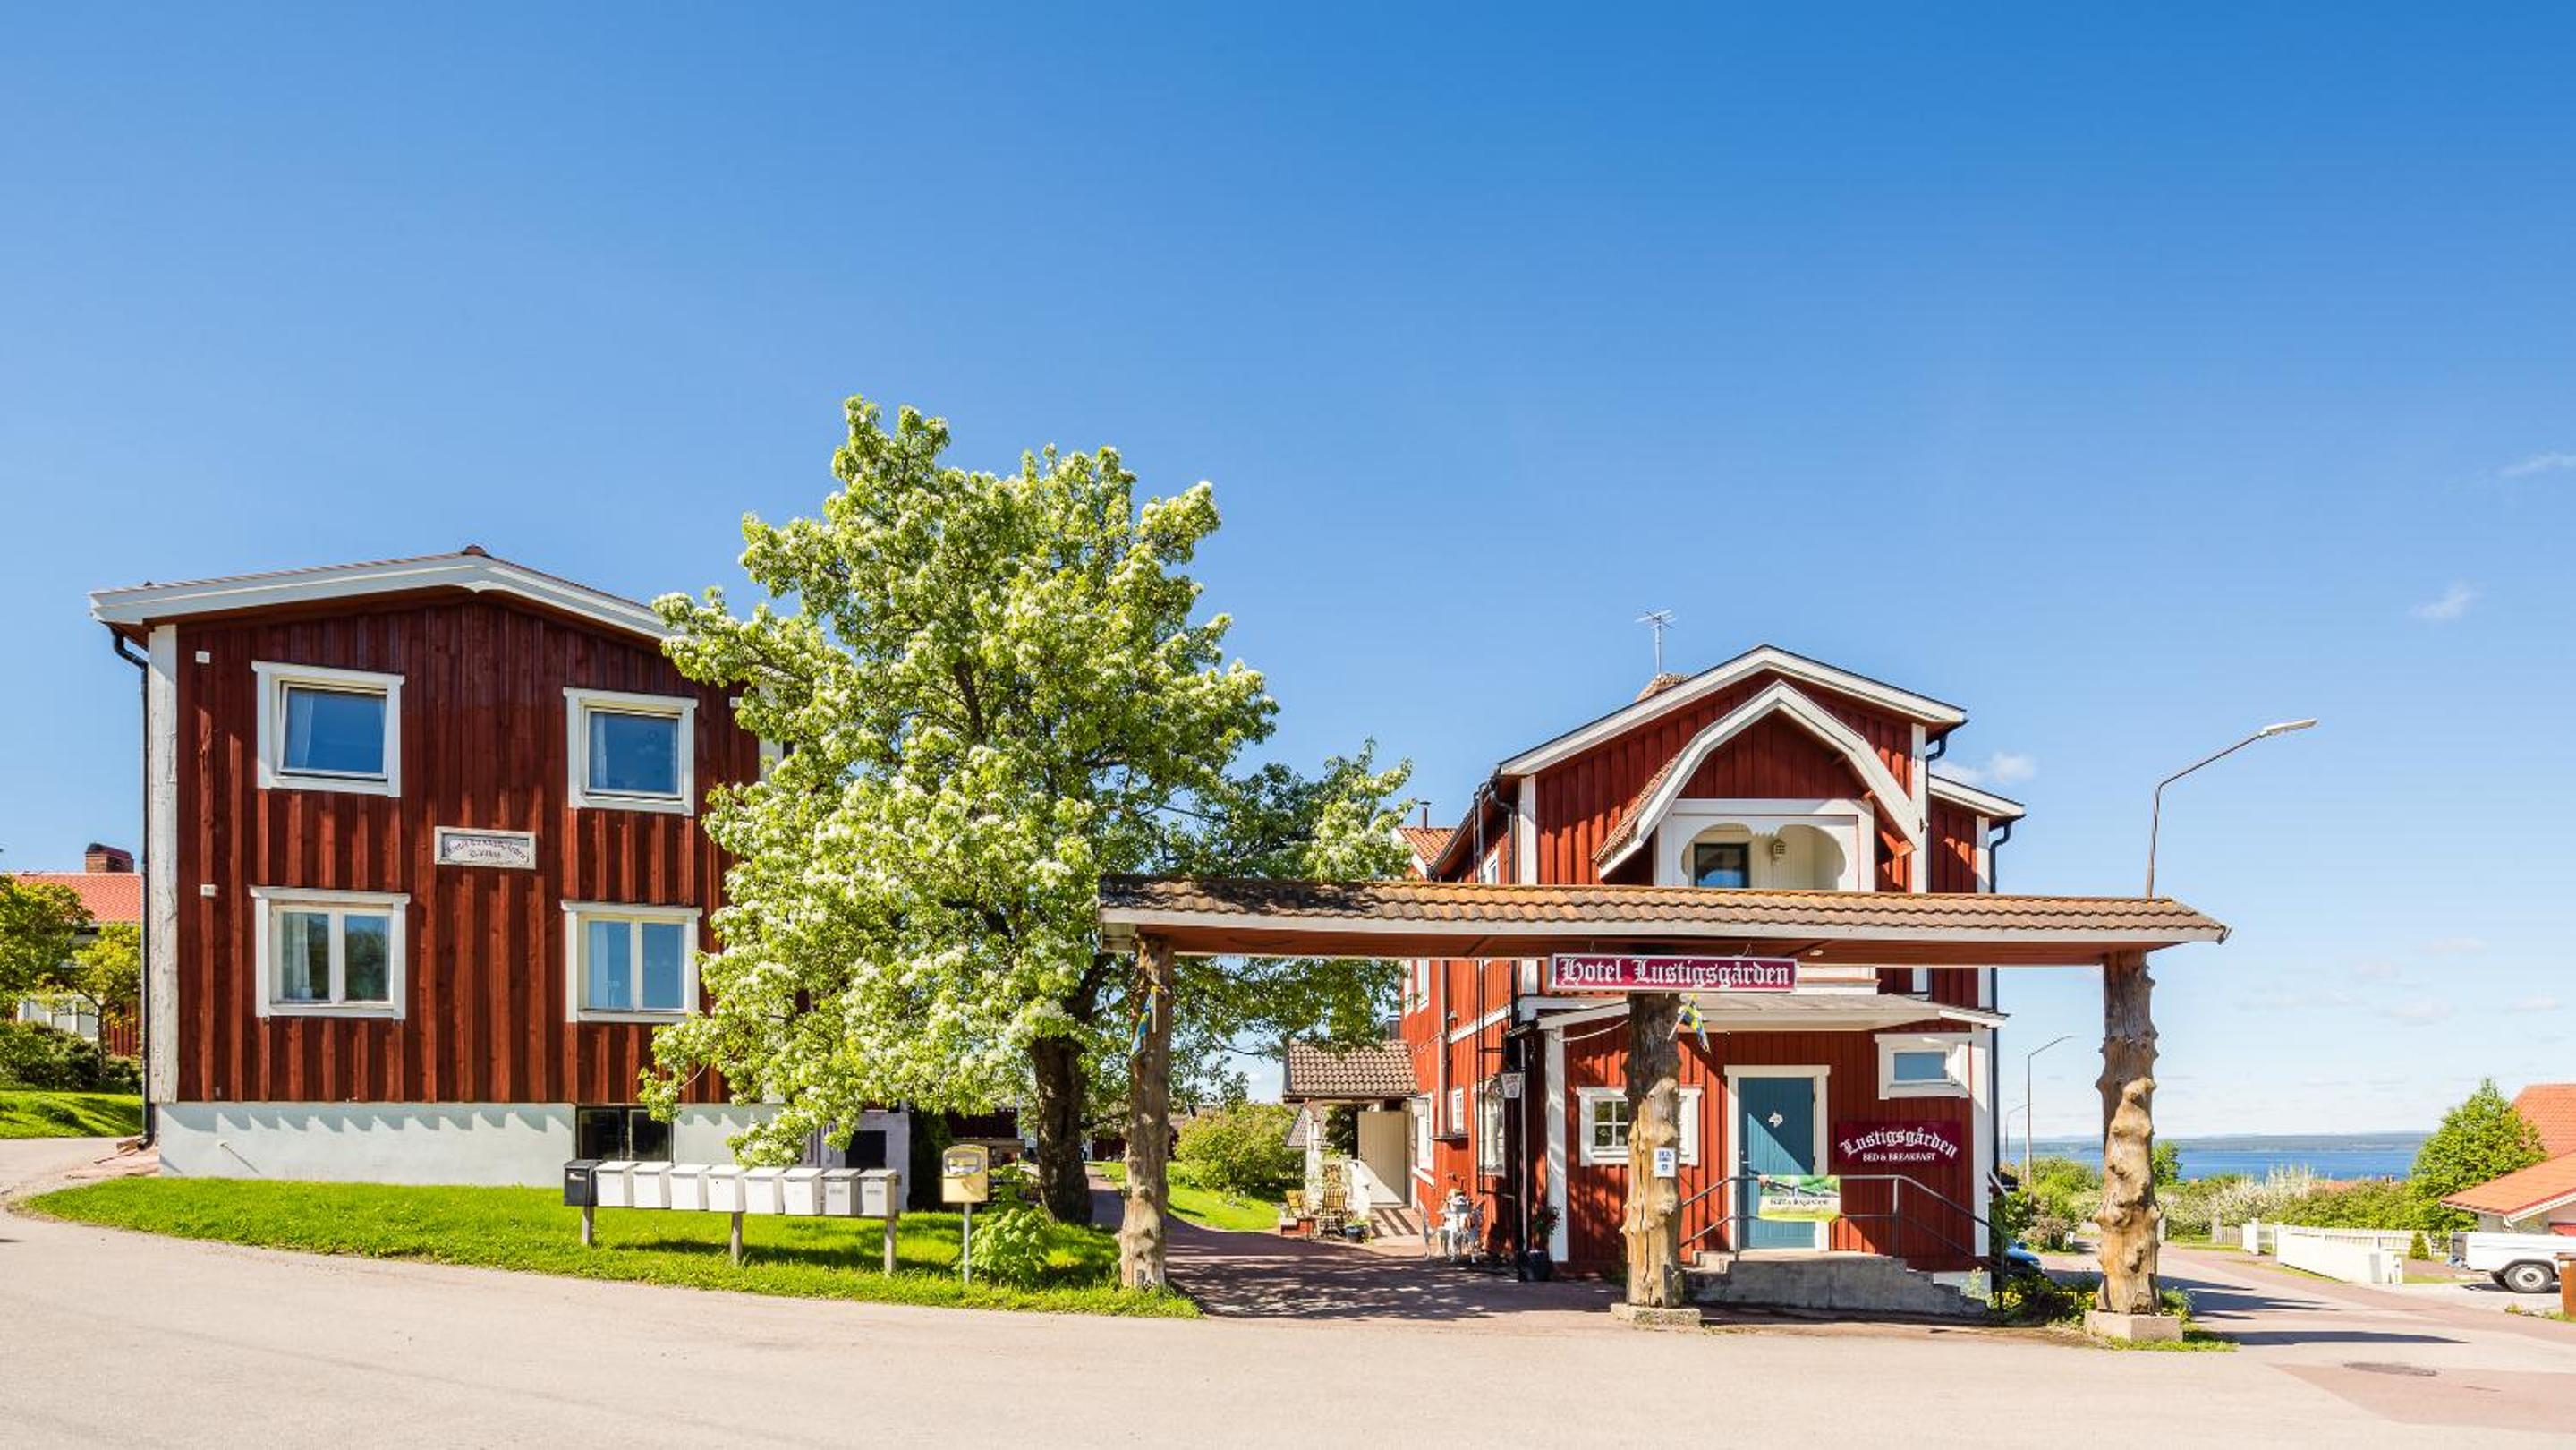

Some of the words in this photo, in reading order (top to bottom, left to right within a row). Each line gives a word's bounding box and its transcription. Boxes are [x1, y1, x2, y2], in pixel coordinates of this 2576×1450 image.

[1560, 959, 1622, 986] Hotel
[1632, 960, 1790, 988] Lustigsgården
[1840, 1127, 1958, 1158] Lustigsgården
[1862, 1152, 1880, 1162] BED
[1880, 1152, 1887, 1162] &
[1888, 1152, 1936, 1162] BREAKFAST
